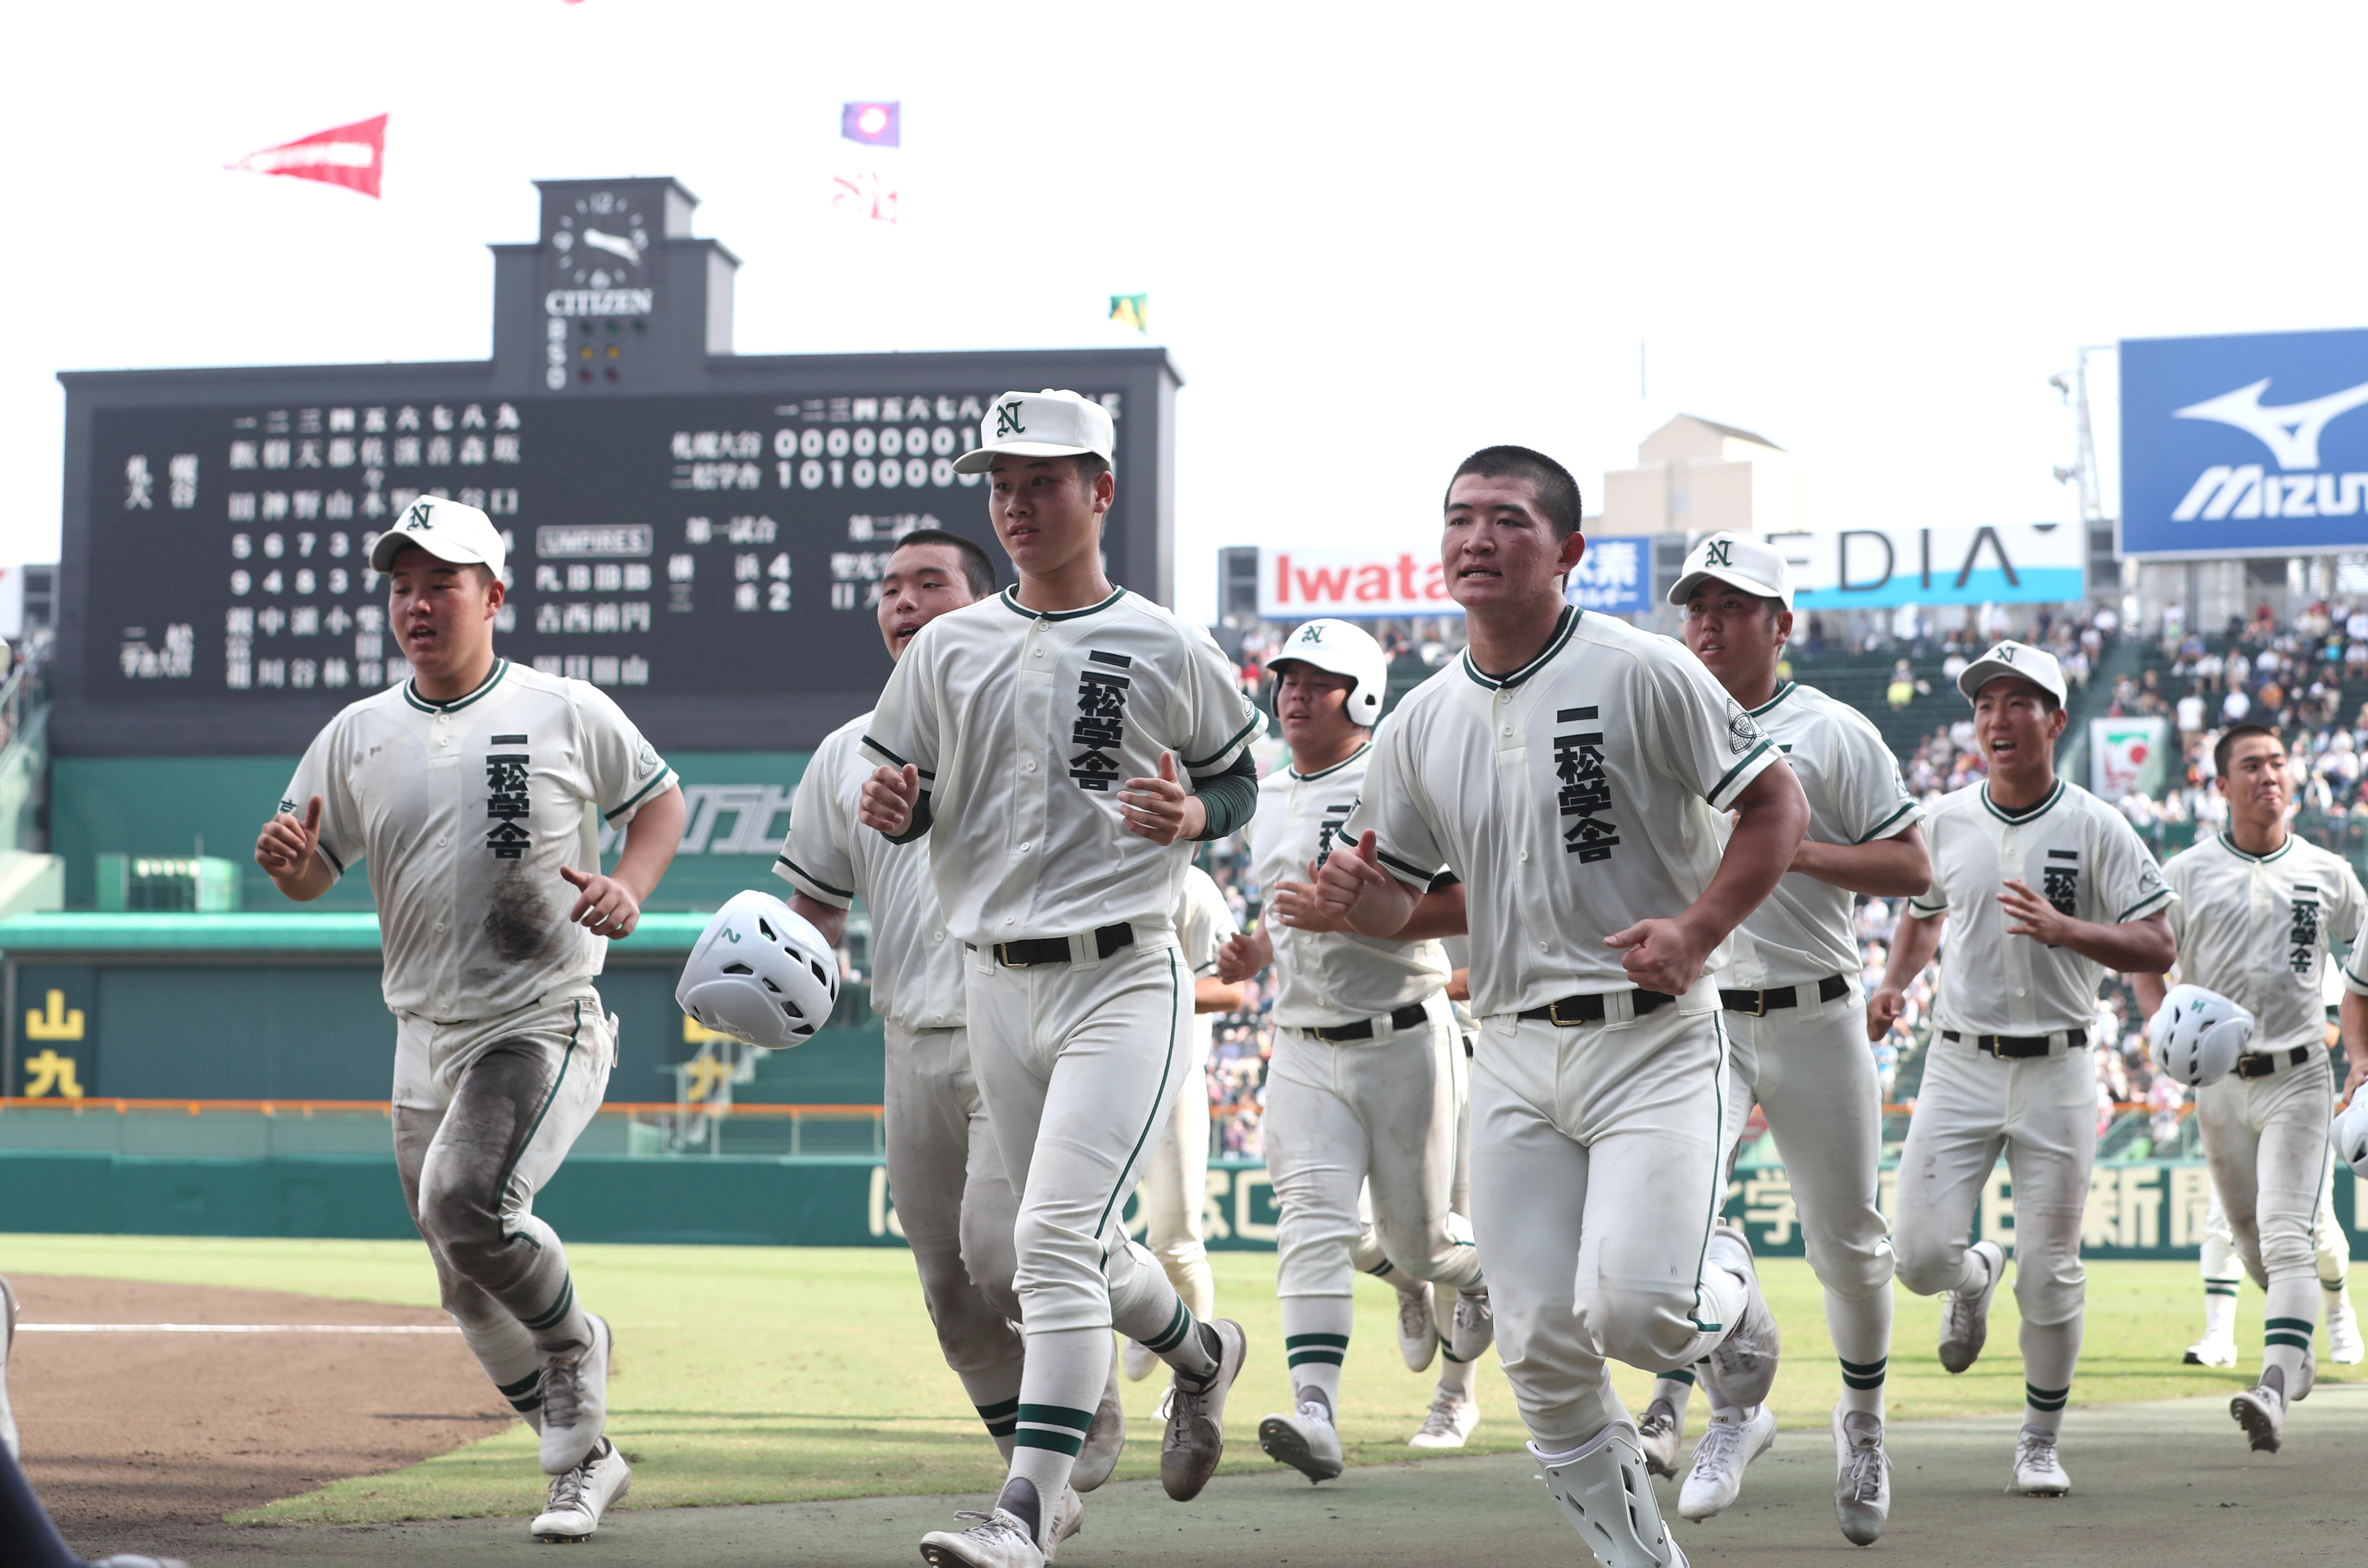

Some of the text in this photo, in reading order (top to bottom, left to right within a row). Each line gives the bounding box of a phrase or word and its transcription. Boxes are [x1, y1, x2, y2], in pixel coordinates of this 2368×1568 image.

[546, 288, 653, 316] CITIZEN
[996, 400, 1025, 437] N
[406, 504, 435, 531] N
[542, 529, 645, 554] UMPIRES
[1705, 540, 1733, 567] N
[767, 552, 792, 581] 4
[1693, 525, 2019, 593] EDIA
[1276, 553, 1452, 604] Iwata
[767, 582, 792, 611] 2
[1301, 626, 1326, 643] N
[1997, 646, 2017, 663] N
[25, 989, 85, 1098] 山九
